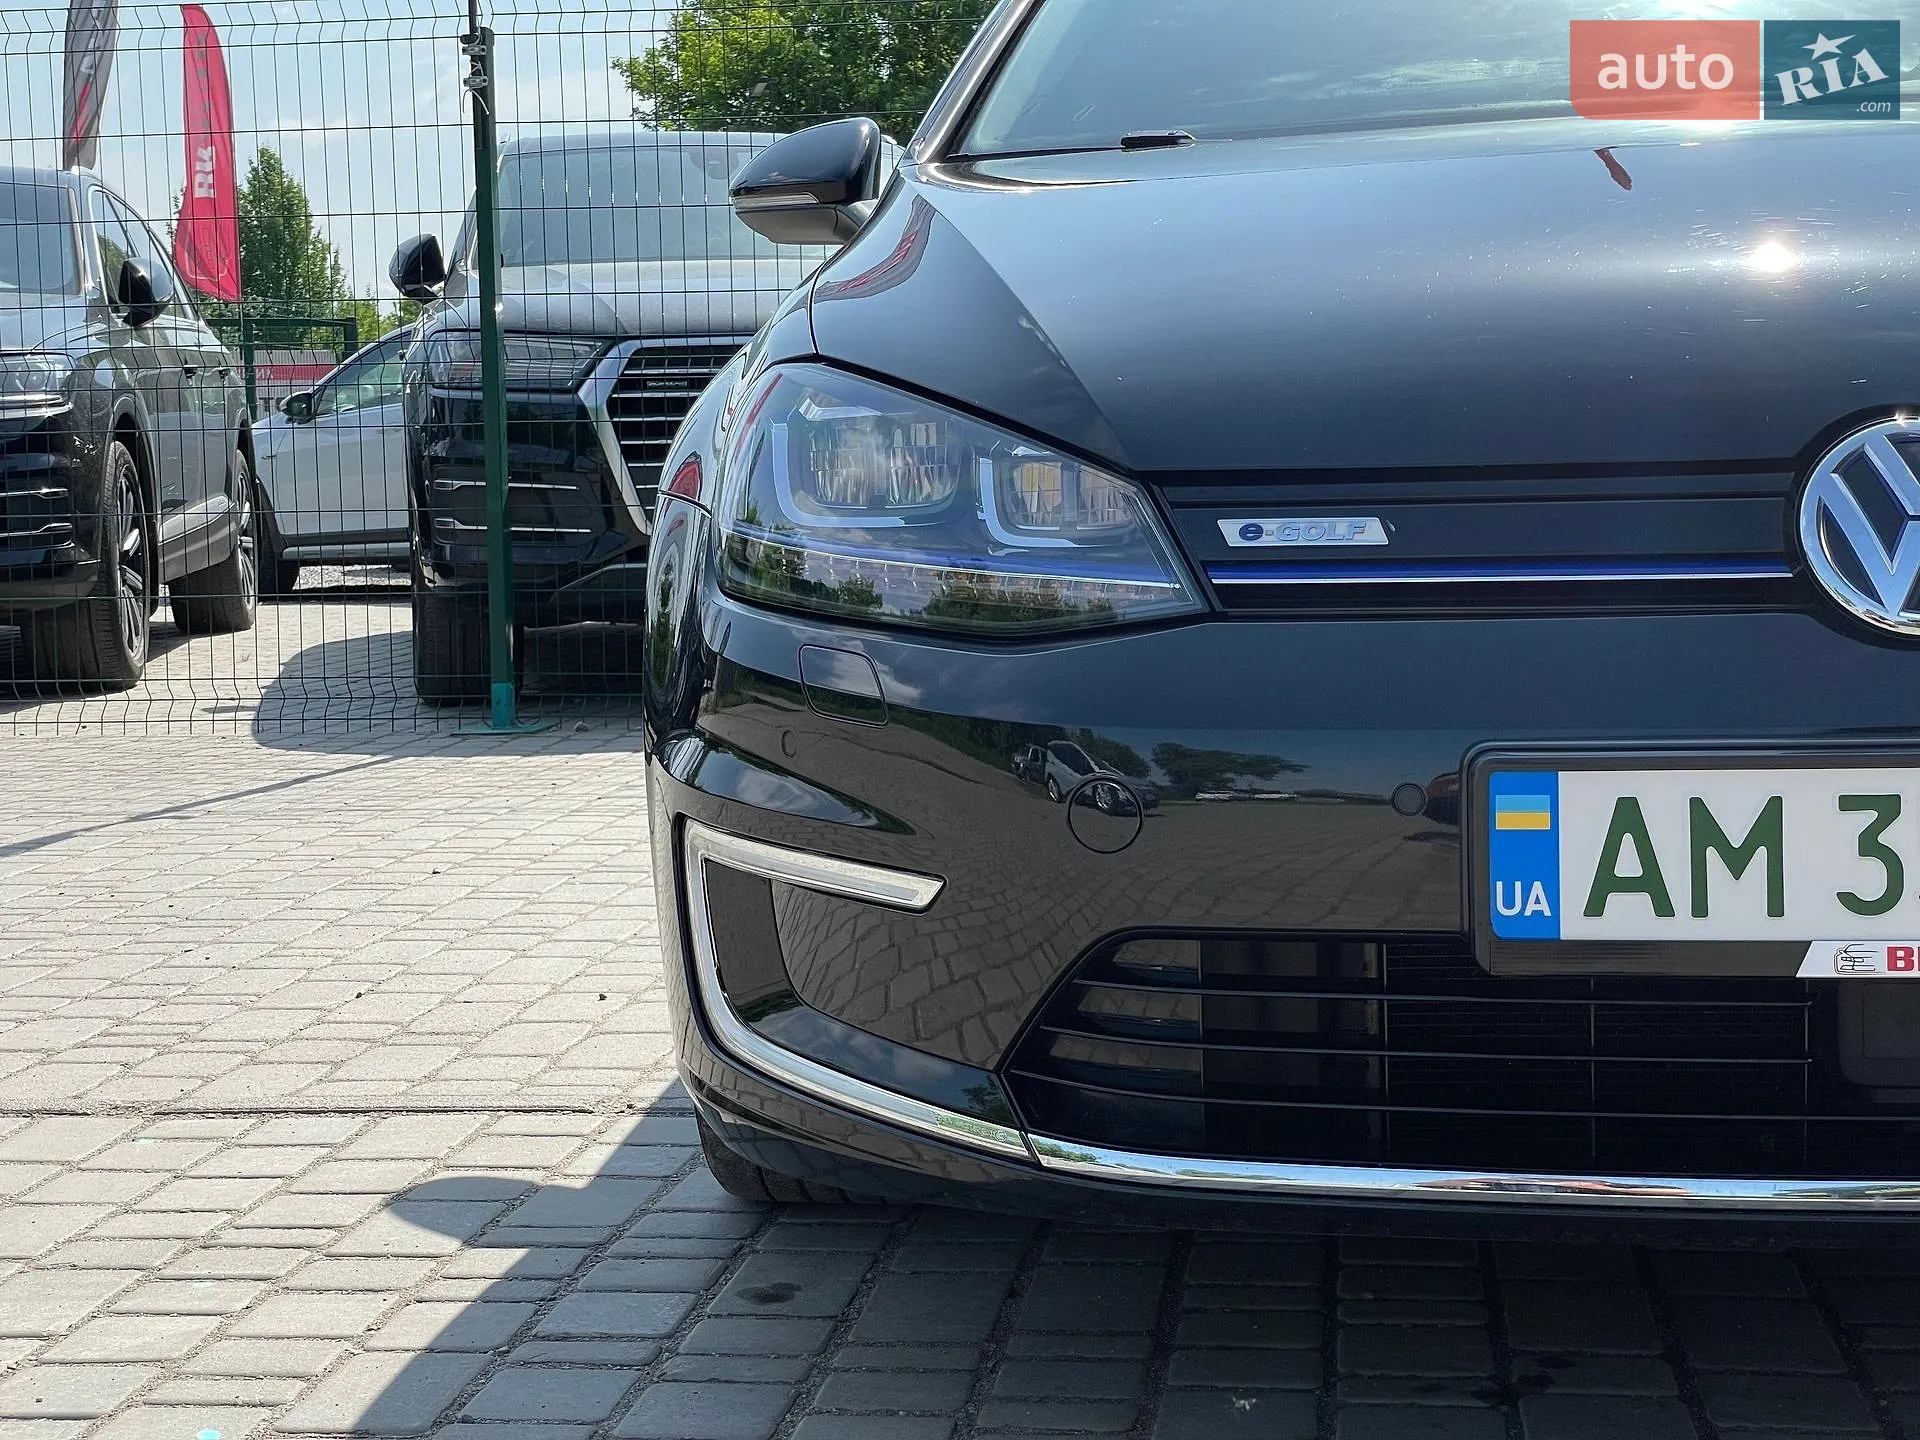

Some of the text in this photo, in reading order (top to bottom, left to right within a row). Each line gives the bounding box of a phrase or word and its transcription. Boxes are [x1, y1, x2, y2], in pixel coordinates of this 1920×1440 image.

[1238, 520, 1367, 542] e-GOLF
[1582, 793, 1920, 919] AM 3
[1496, 880, 1552, 917] UA
[1886, 945, 1920, 972] B
